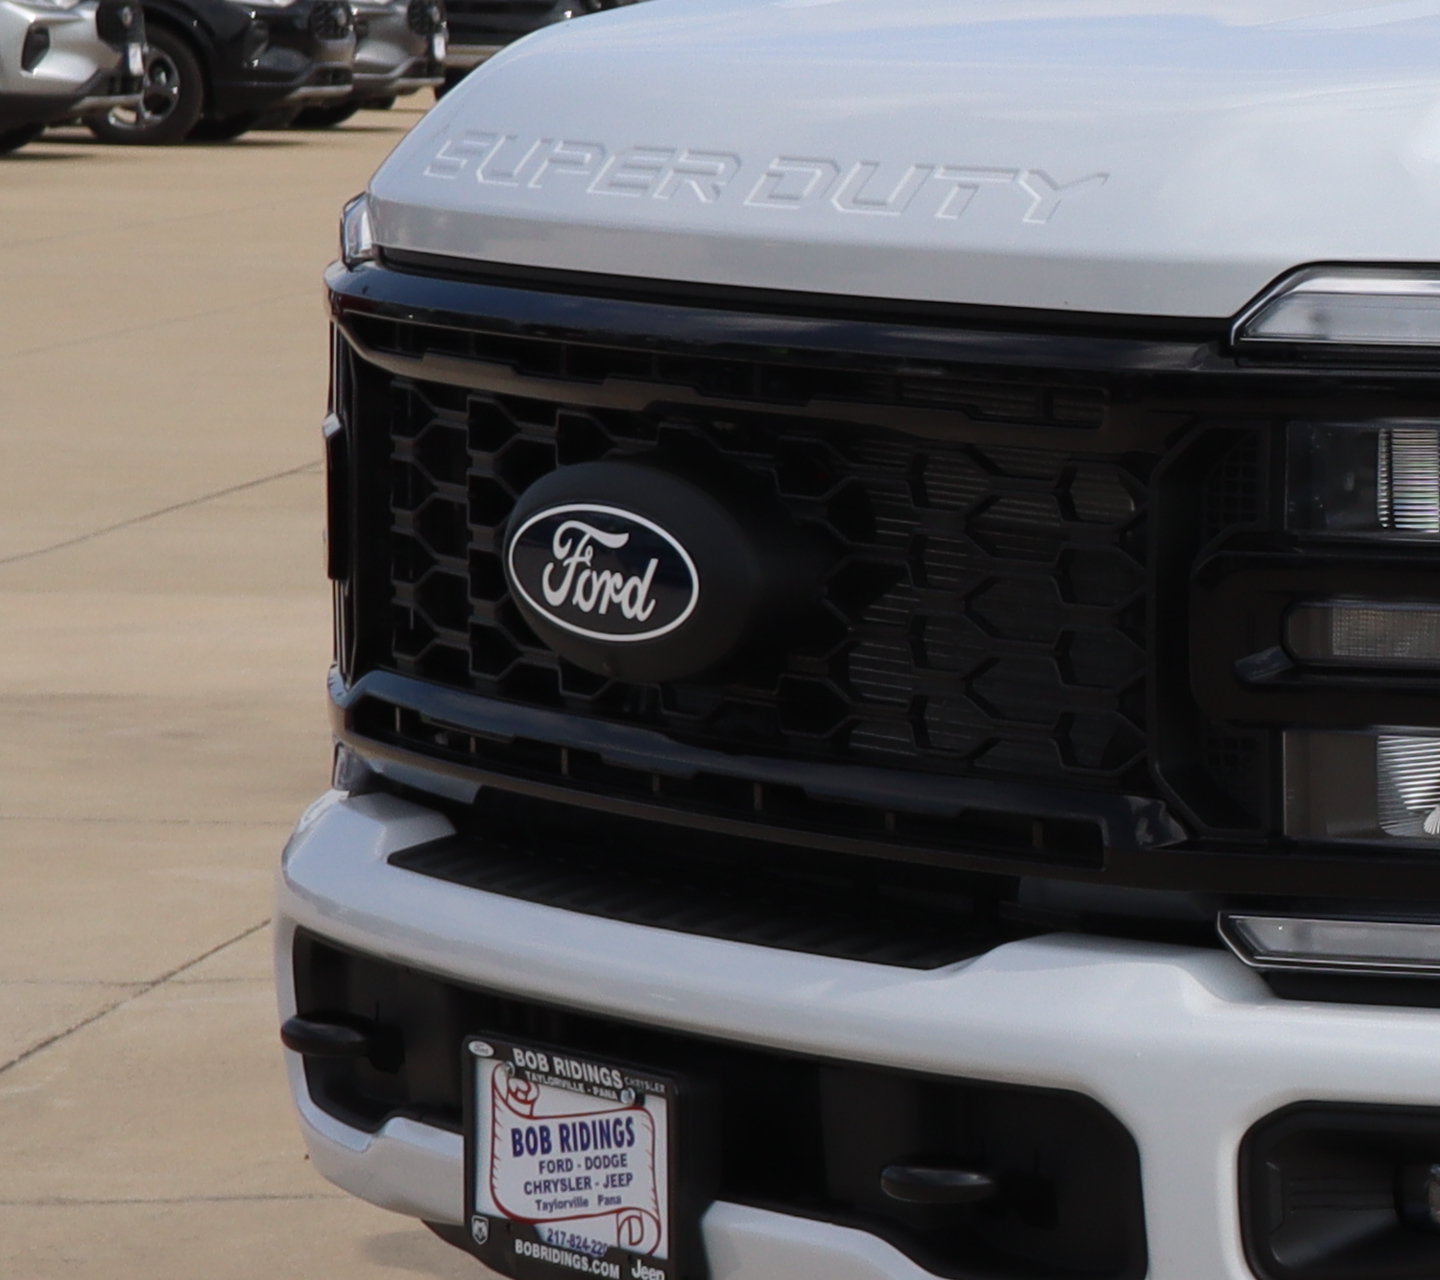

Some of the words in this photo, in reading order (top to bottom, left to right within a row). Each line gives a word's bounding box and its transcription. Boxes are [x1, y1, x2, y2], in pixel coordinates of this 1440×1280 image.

[423, 130, 742, 204] SUPER
[743, 154, 1111, 225] DUTY
[542, 520, 659, 622] Ford
[513, 1047, 549, 1072] BOB
[553, 1056, 623, 1089] RIDINGS
[526, 1071, 585, 1093] TAYLORVILLE
[624, 1076, 666, 1094] CHRYSLER
[511, 1125, 553, 1158] BOB
[558, 1116, 636, 1154] RIDINGS
[538, 1157, 574, 1175] FORD
[584, 1153, 628, 1170] DODGE
[523, 1175, 592, 1195] CHRYSLER
[603, 1173, 633, 1189] JEEP
[535, 1196, 589, 1213] Taylorville
[598, 1194, 622, 1206] Pana
[514, 1238, 620, 1280] BOBRIDINGS.COM
